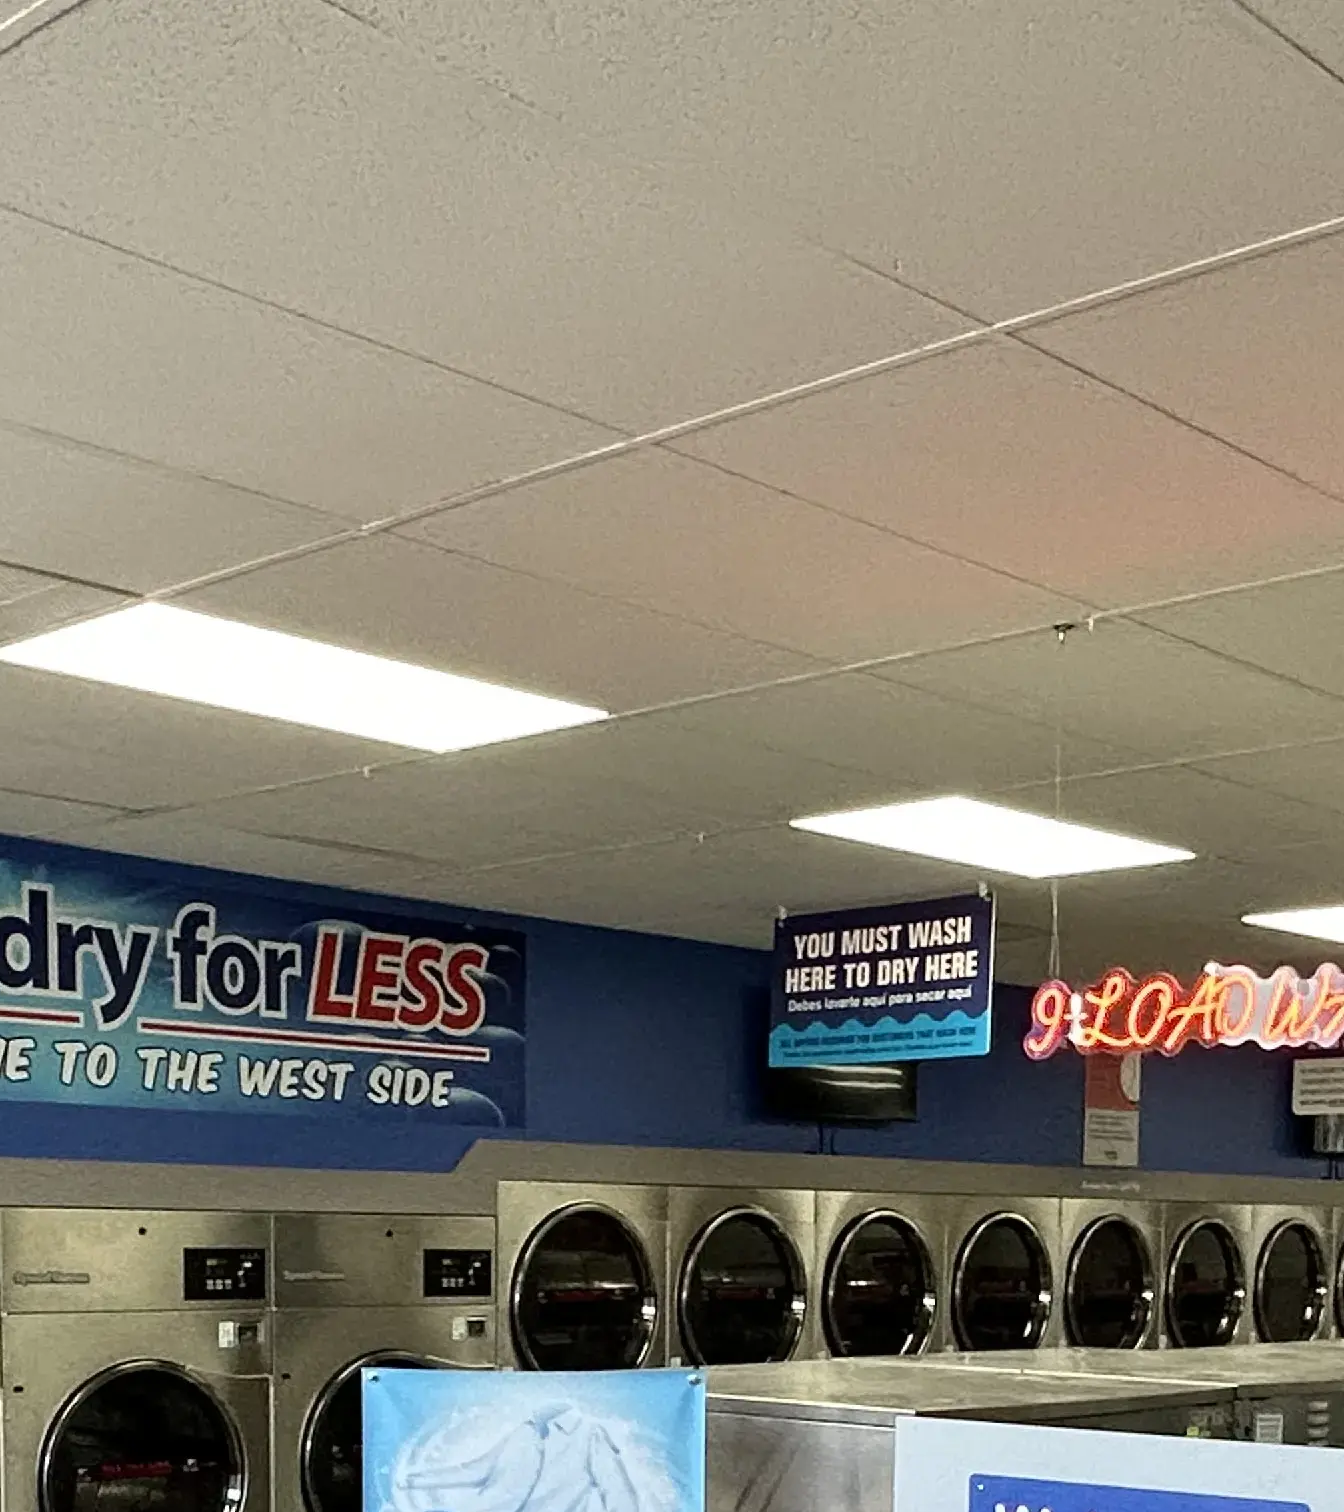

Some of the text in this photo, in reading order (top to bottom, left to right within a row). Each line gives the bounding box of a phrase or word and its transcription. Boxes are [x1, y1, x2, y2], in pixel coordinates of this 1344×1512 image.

[794, 916, 972, 960] YOU MUST WASH
[166, 902, 301, 1019] for
[306, 925, 488, 1036] LESS
[785, 950, 979, 993] HERE TO DRY HERE
[788, 997, 822, 1012] Debes
[888, 993, 914, 1006] para
[916, 989, 946, 1003] secar
[55, 1041, 118, 1088] TO
[138, 1047, 224, 1094] THE
[238, 1055, 355, 1101] WEST
[366, 1065, 454, 1109] SIDE
